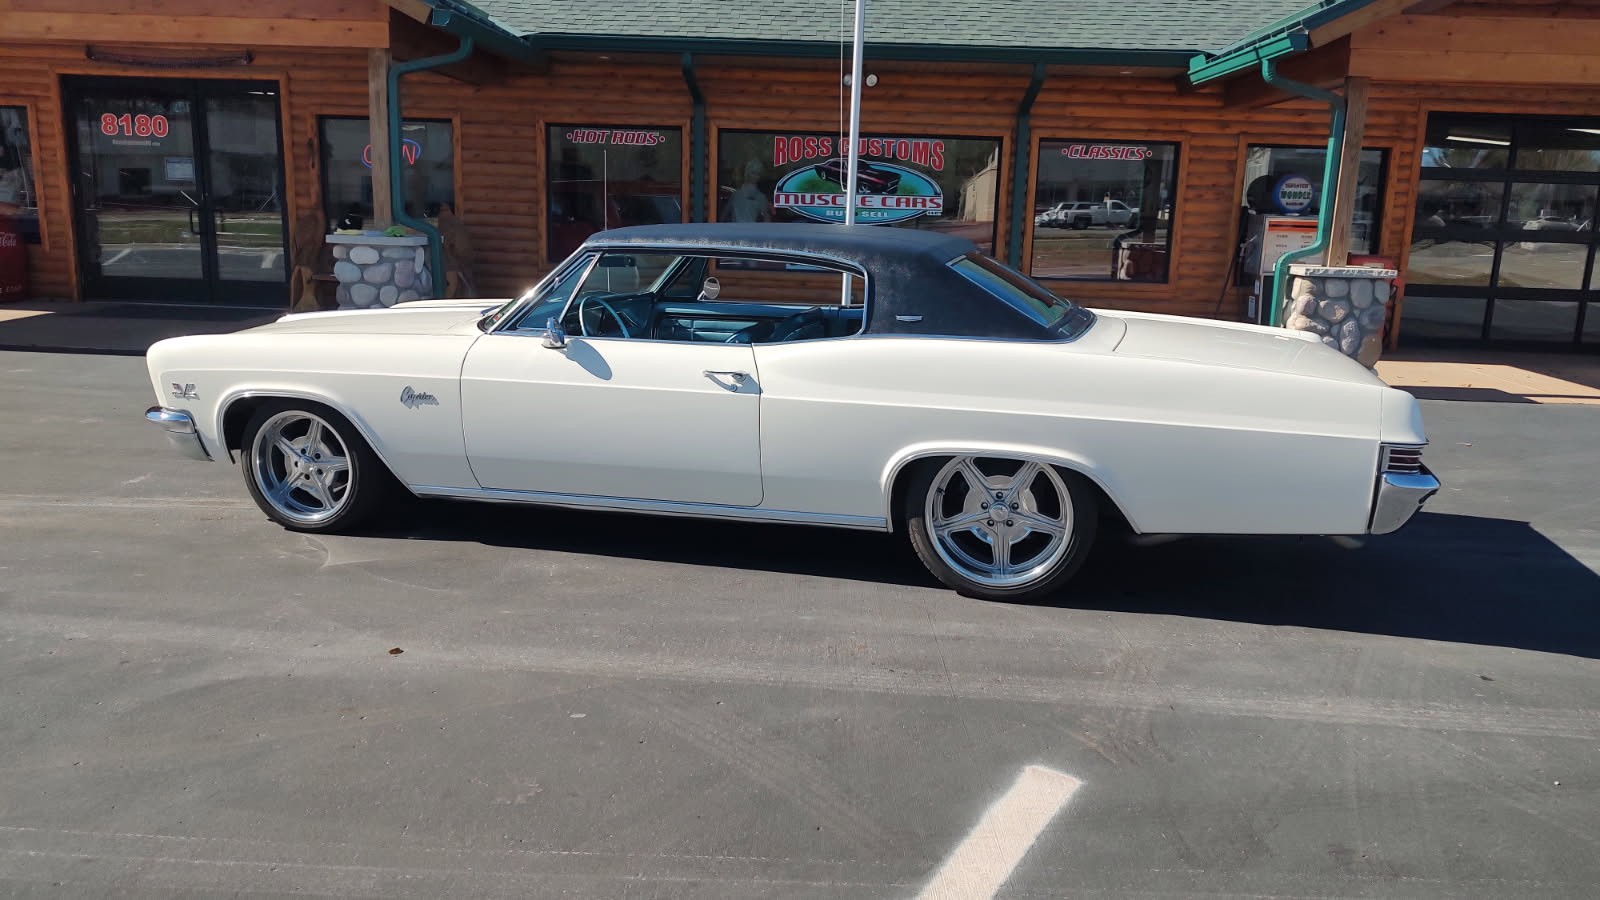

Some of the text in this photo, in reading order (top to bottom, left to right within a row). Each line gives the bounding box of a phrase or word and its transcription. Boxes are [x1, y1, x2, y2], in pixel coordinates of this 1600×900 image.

[101, 112, 169, 138] 8180
[572, 129, 660, 146] HOT RODS
[363, 144, 416, 165] ON
[774, 135, 945, 171] ROSS CUSTOMS
[1067, 144, 1147, 160] CLASSICS
[881, 196, 942, 209] CARS
[825, 209, 889, 218] BU SELL
